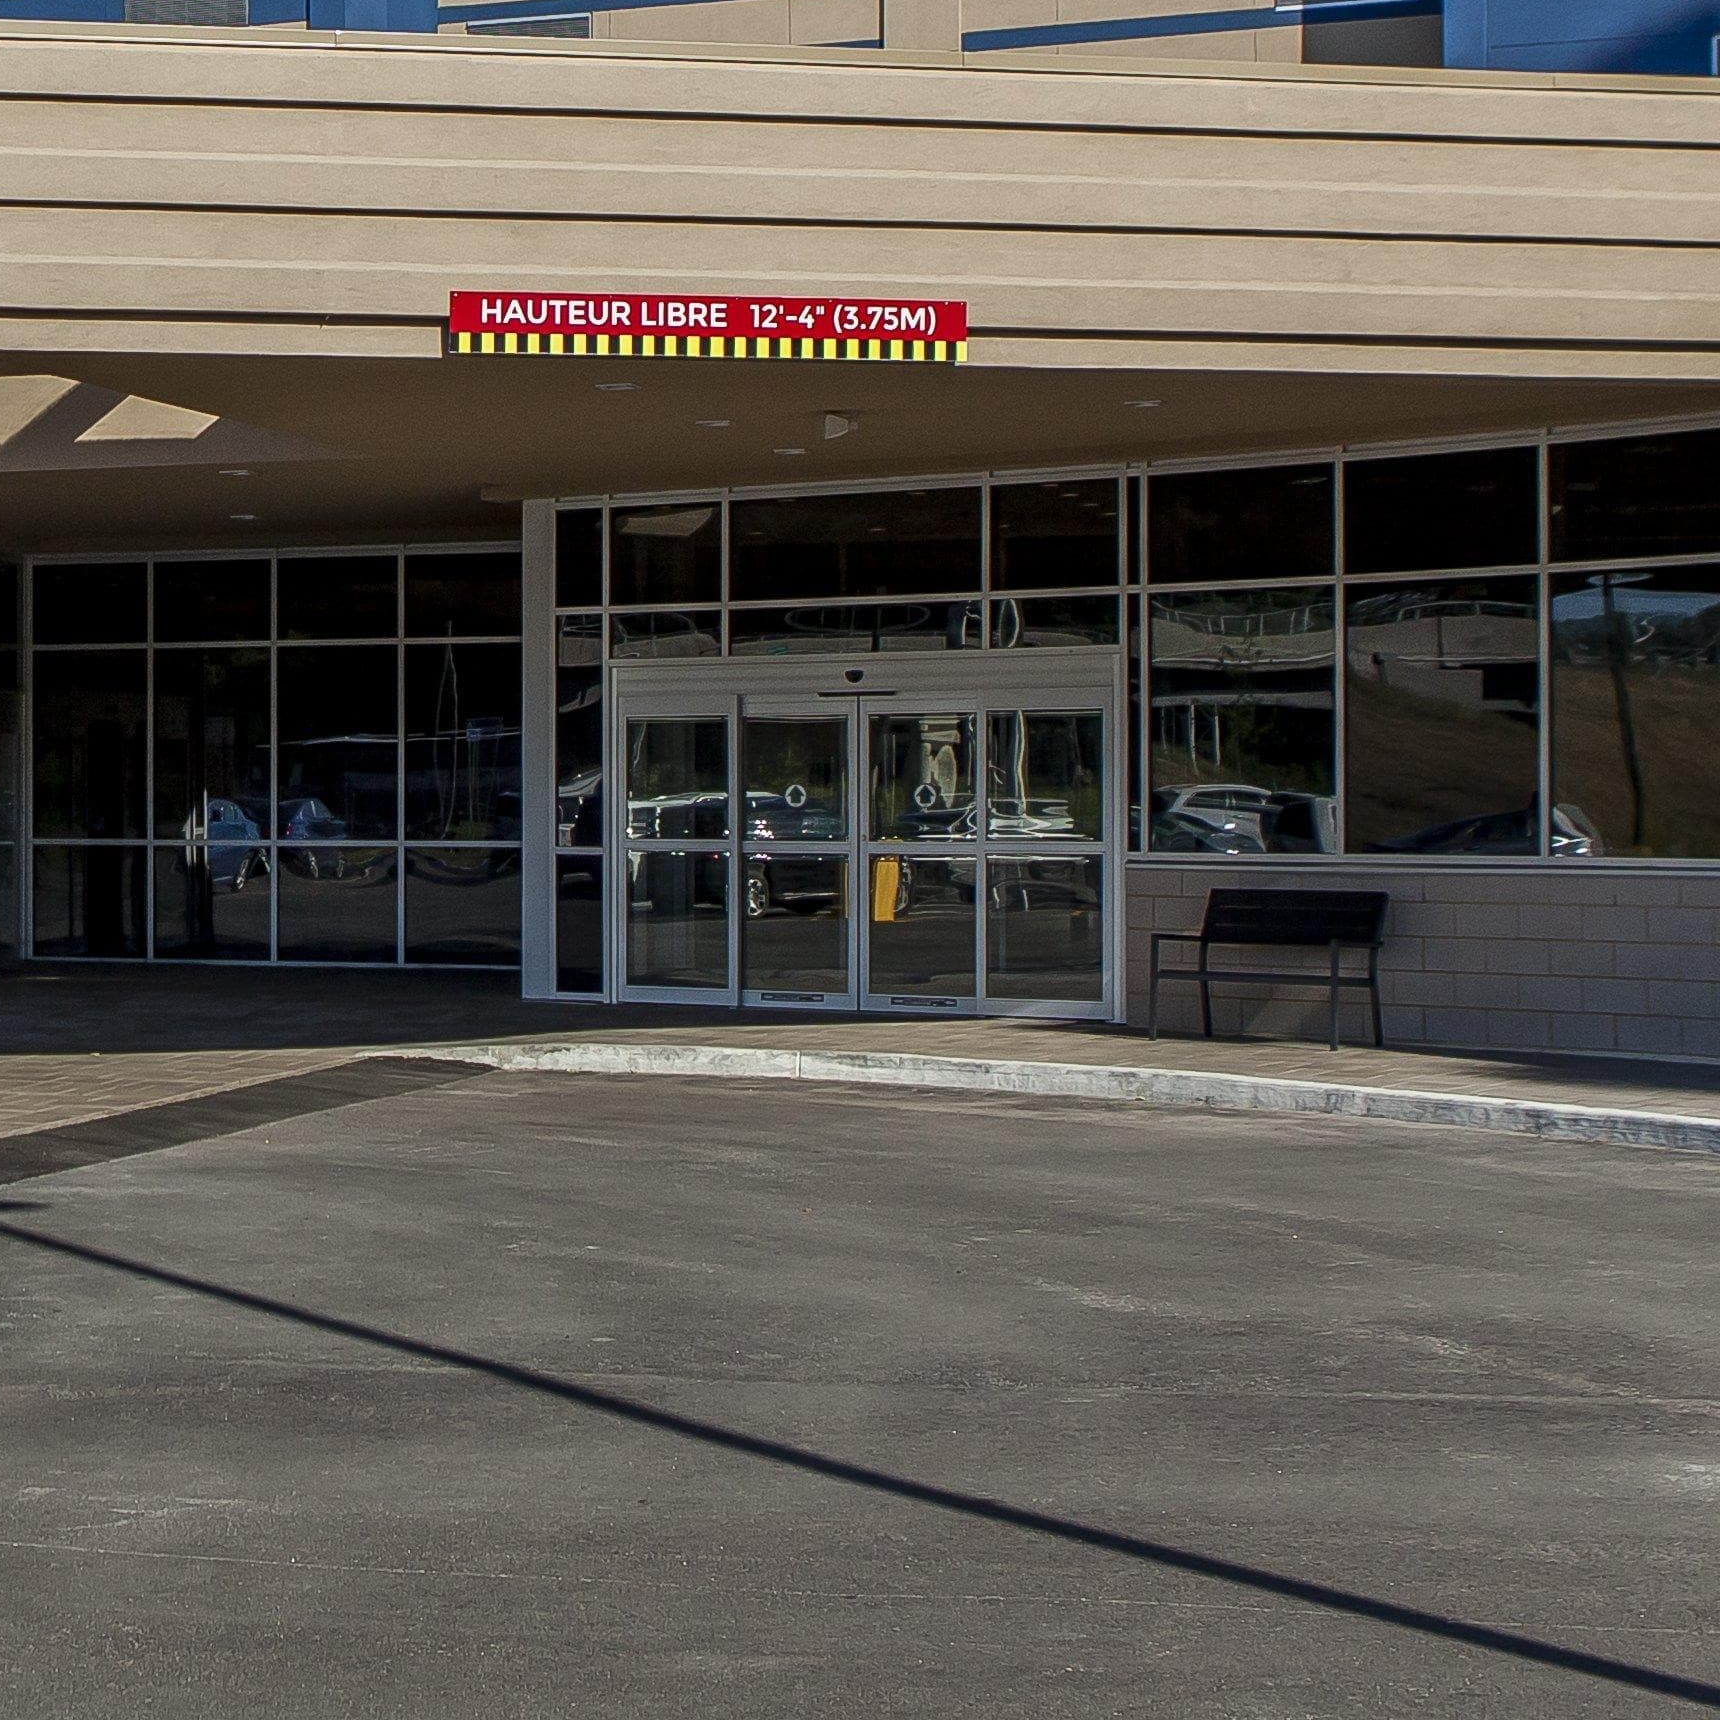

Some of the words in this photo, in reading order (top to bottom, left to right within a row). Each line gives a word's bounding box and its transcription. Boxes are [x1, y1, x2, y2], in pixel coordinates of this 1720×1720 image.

[480, 298, 631, 326] HAUTEUR
[641, 301, 728, 328] LIBRE
[749, 304, 825, 329] 12'-4"
[833, 303, 937, 336] (3.75M)
